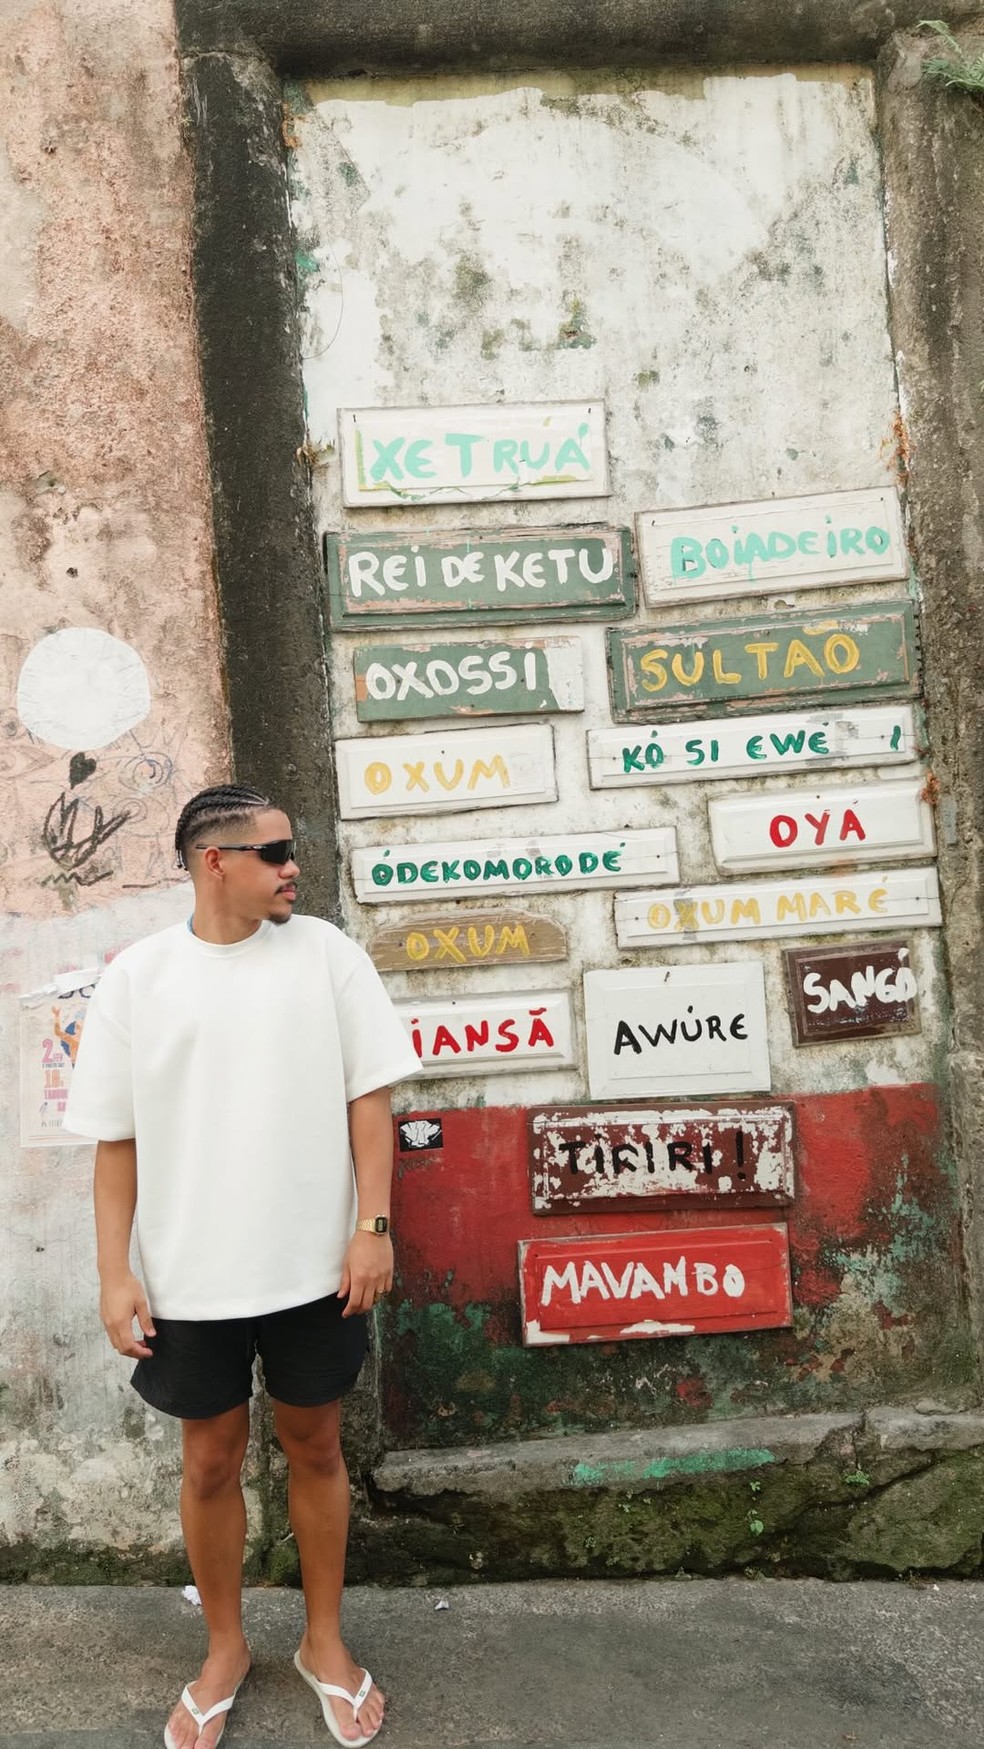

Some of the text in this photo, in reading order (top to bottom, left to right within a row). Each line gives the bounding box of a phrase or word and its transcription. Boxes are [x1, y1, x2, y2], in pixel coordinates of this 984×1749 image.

[440, 551, 485, 587] DE
[494, 548, 614, 592] KETU
[365, 651, 536, 701] OXOSSI
[640, 619, 860, 692] SULTÃO
[685, 739, 719, 766] SI
[364, 754, 511, 796] OXUM
[647, 898, 762, 931] OXUM
[406, 924, 530, 963] OXUM
[803, 947, 918, 1014] SANGÓ
[541, 1256, 745, 1306] MAVAMBO
